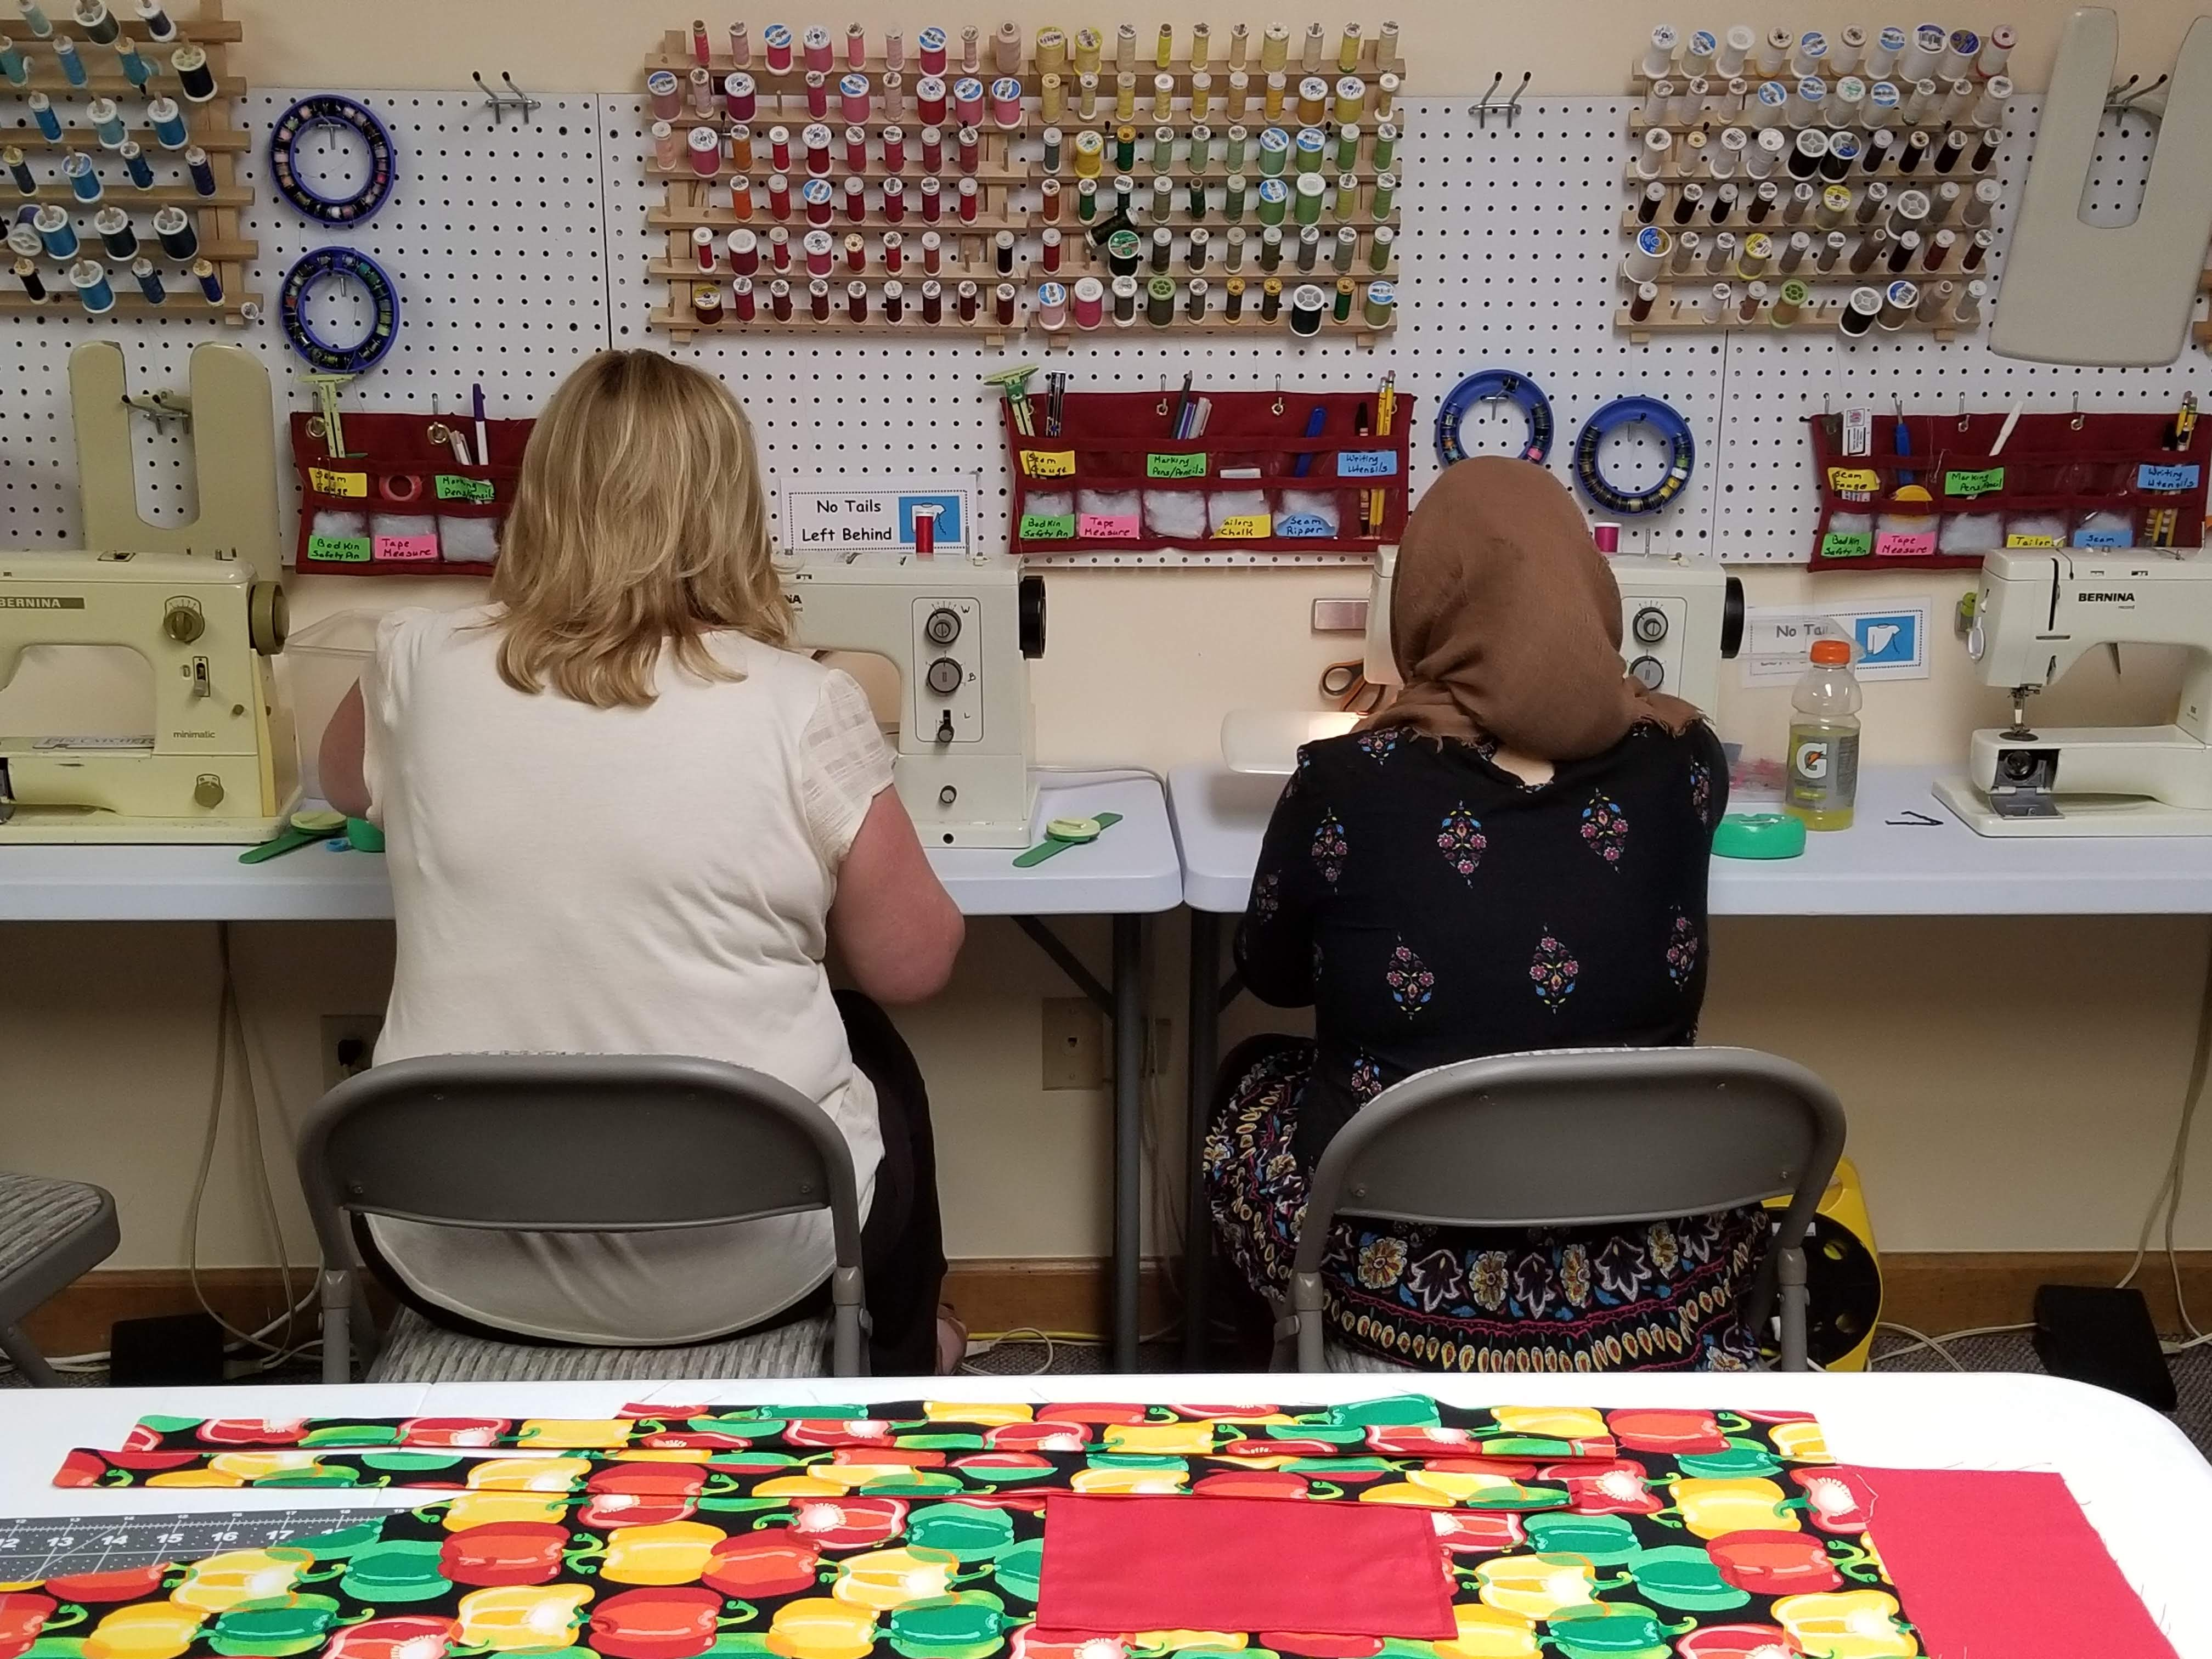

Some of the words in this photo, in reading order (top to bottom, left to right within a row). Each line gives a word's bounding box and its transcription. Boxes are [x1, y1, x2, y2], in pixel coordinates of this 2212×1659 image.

[1154, 456, 1189, 467] Marking
[816, 500, 838, 513] No
[845, 499, 881, 512] Tails
[1090, 517, 1114, 529] Tape
[1290, 517, 1321, 525] Seam
[802, 528, 836, 542] Left
[843, 527, 892, 541] Behind
[1286, 526, 1323, 536] Ripper
[382, 538, 409, 550] Tape
[1892, 535, 1916, 546] Tape
[1882, 545, 1927, 554] Measure
[0, 598, 61, 608] BERNINA
[2078, 593, 2135, 602] BERNINA
[961, 606, 970, 614] W
[1776, 625, 1796, 638] No
[1796, 742, 1827, 779] G
[47, 1537, 74, 1547] 13
[101, 1536, 128, 1545] 14
[157, 1533, 185, 1543] 15
[211, 1532, 239, 1542] 16
[266, 1530, 294, 1540] 17
